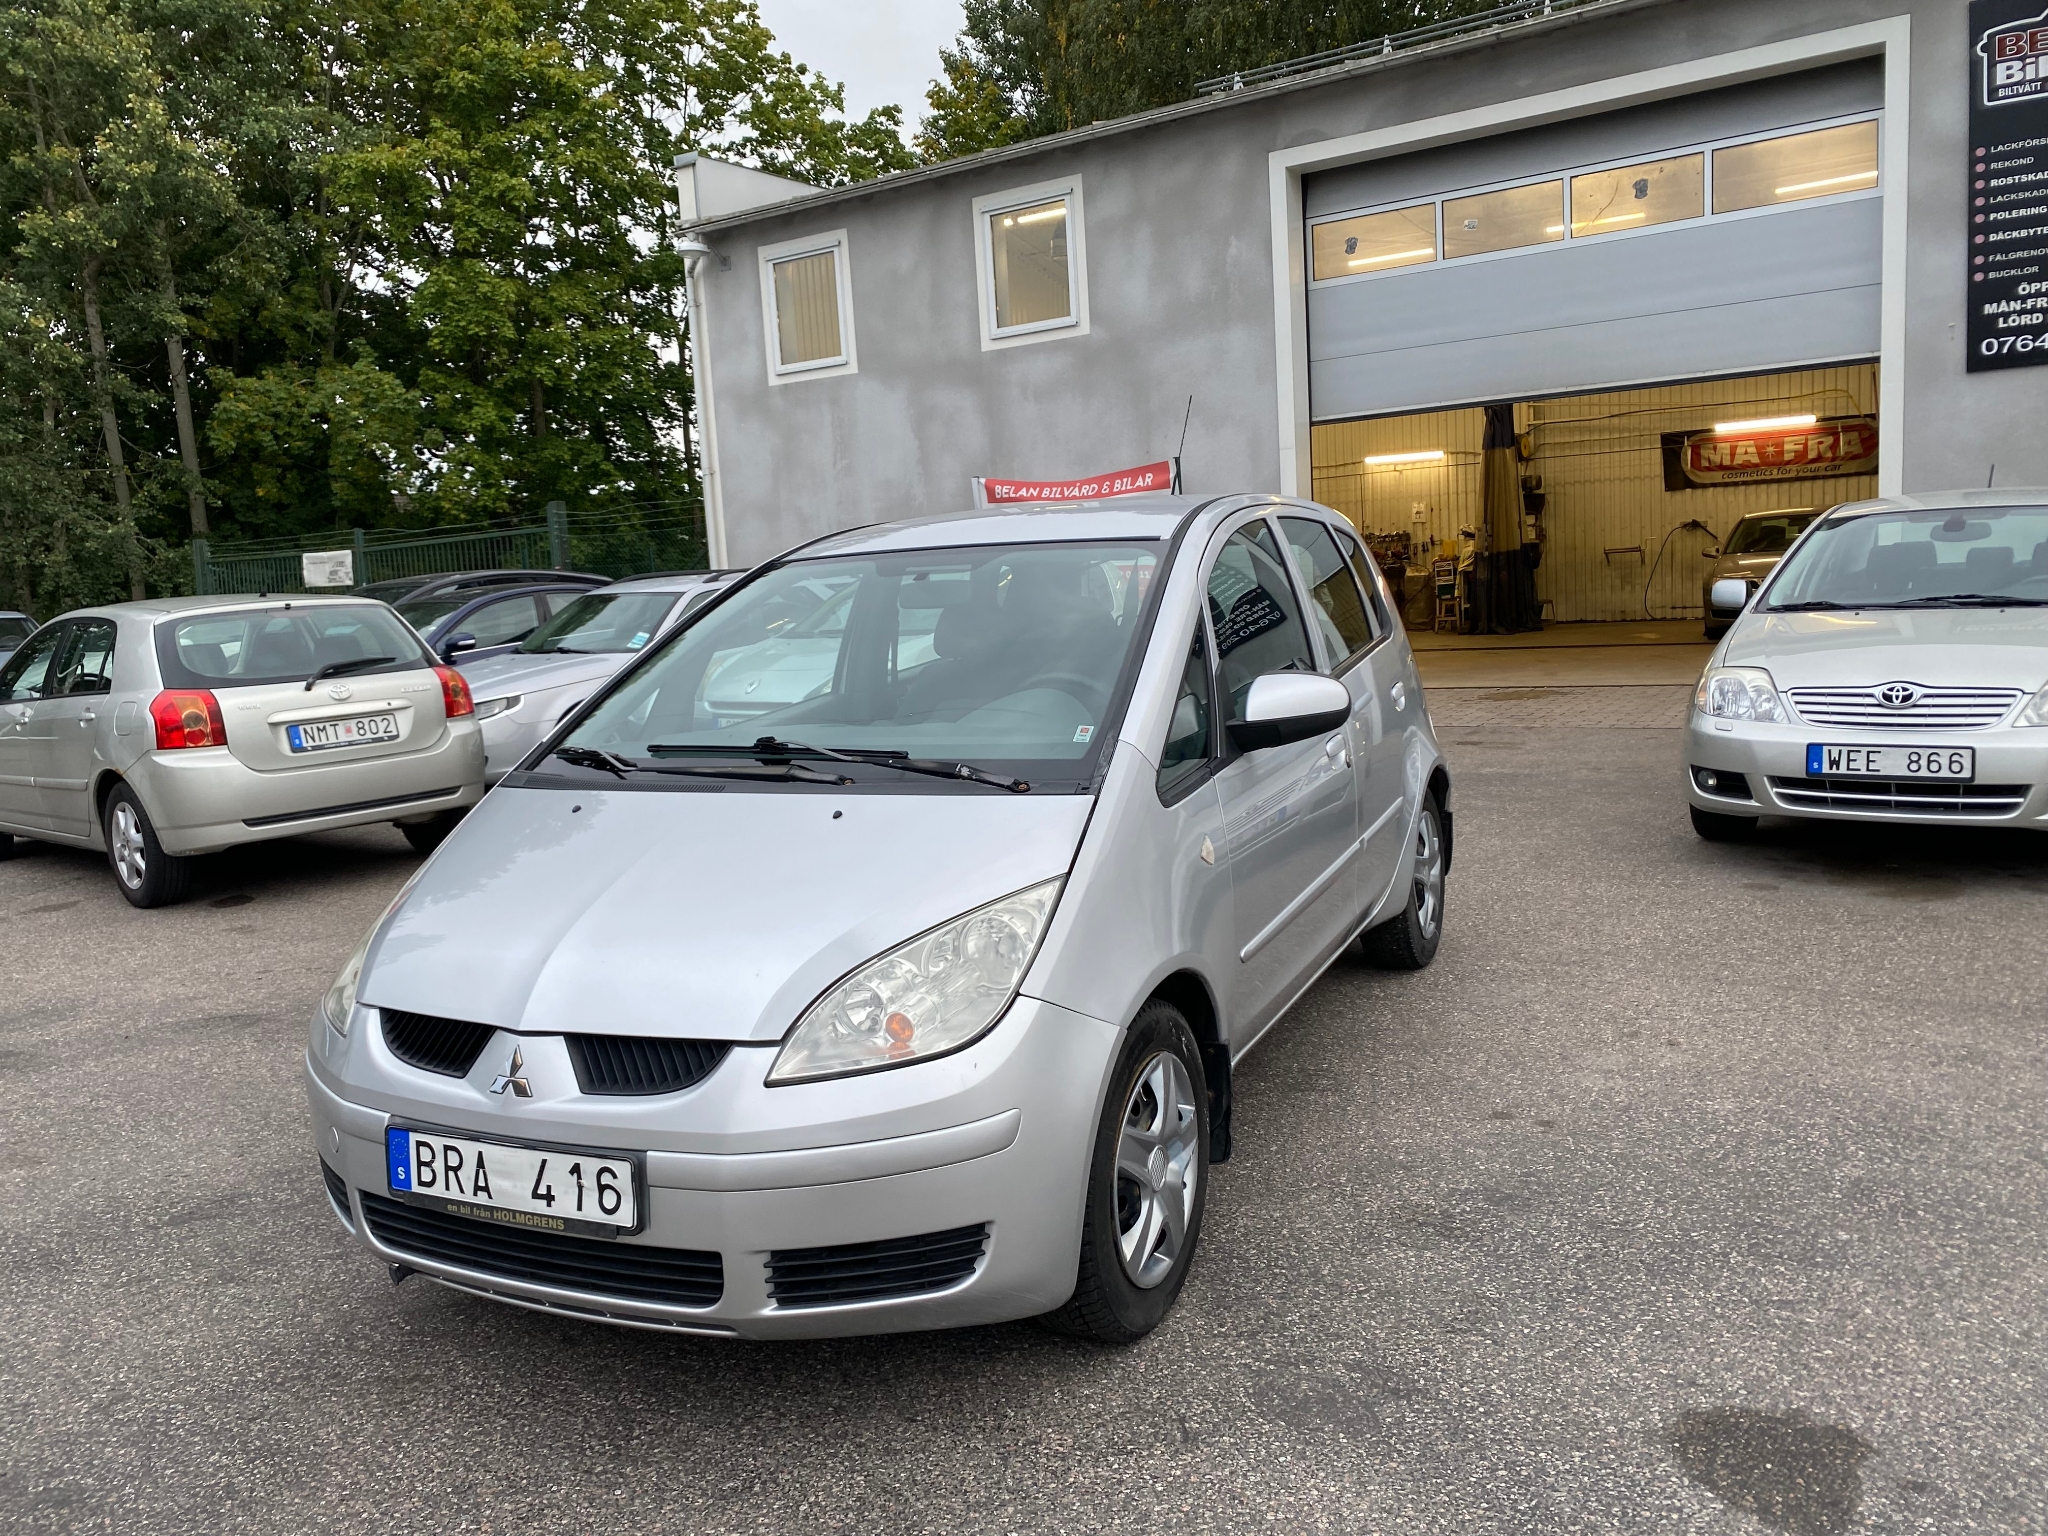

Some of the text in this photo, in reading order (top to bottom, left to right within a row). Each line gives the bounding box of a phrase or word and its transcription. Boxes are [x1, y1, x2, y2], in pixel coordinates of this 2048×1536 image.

[1999, 81, 2042, 97] BILTVÄTT
[1991, 137, 2048, 153] LACKFÖRS
[1990, 156, 2034, 170] REKOND
[1990, 188, 2048, 203] LACKSKAD
[1989, 205, 2048, 221] POLERING
[1988, 265, 2040, 279] BUCKLOR
[1998, 312, 2044, 328] LÖRD
[1981, 332, 2048, 355] 0764
[1721, 463, 1843, 480] cosmetics for your car
[995, 472, 1153, 499] BELAN BILVÅRD & BILAR
[302, 723, 340, 744] NMT
[357, 717, 393, 737] 802
[1828, 749, 1965, 775] WEE 866
[397, 1166, 406, 1180] S
[415, 1139, 622, 1216] BRA 416
[447, 1204, 565, 1230] en bil från HOLMGRENS
